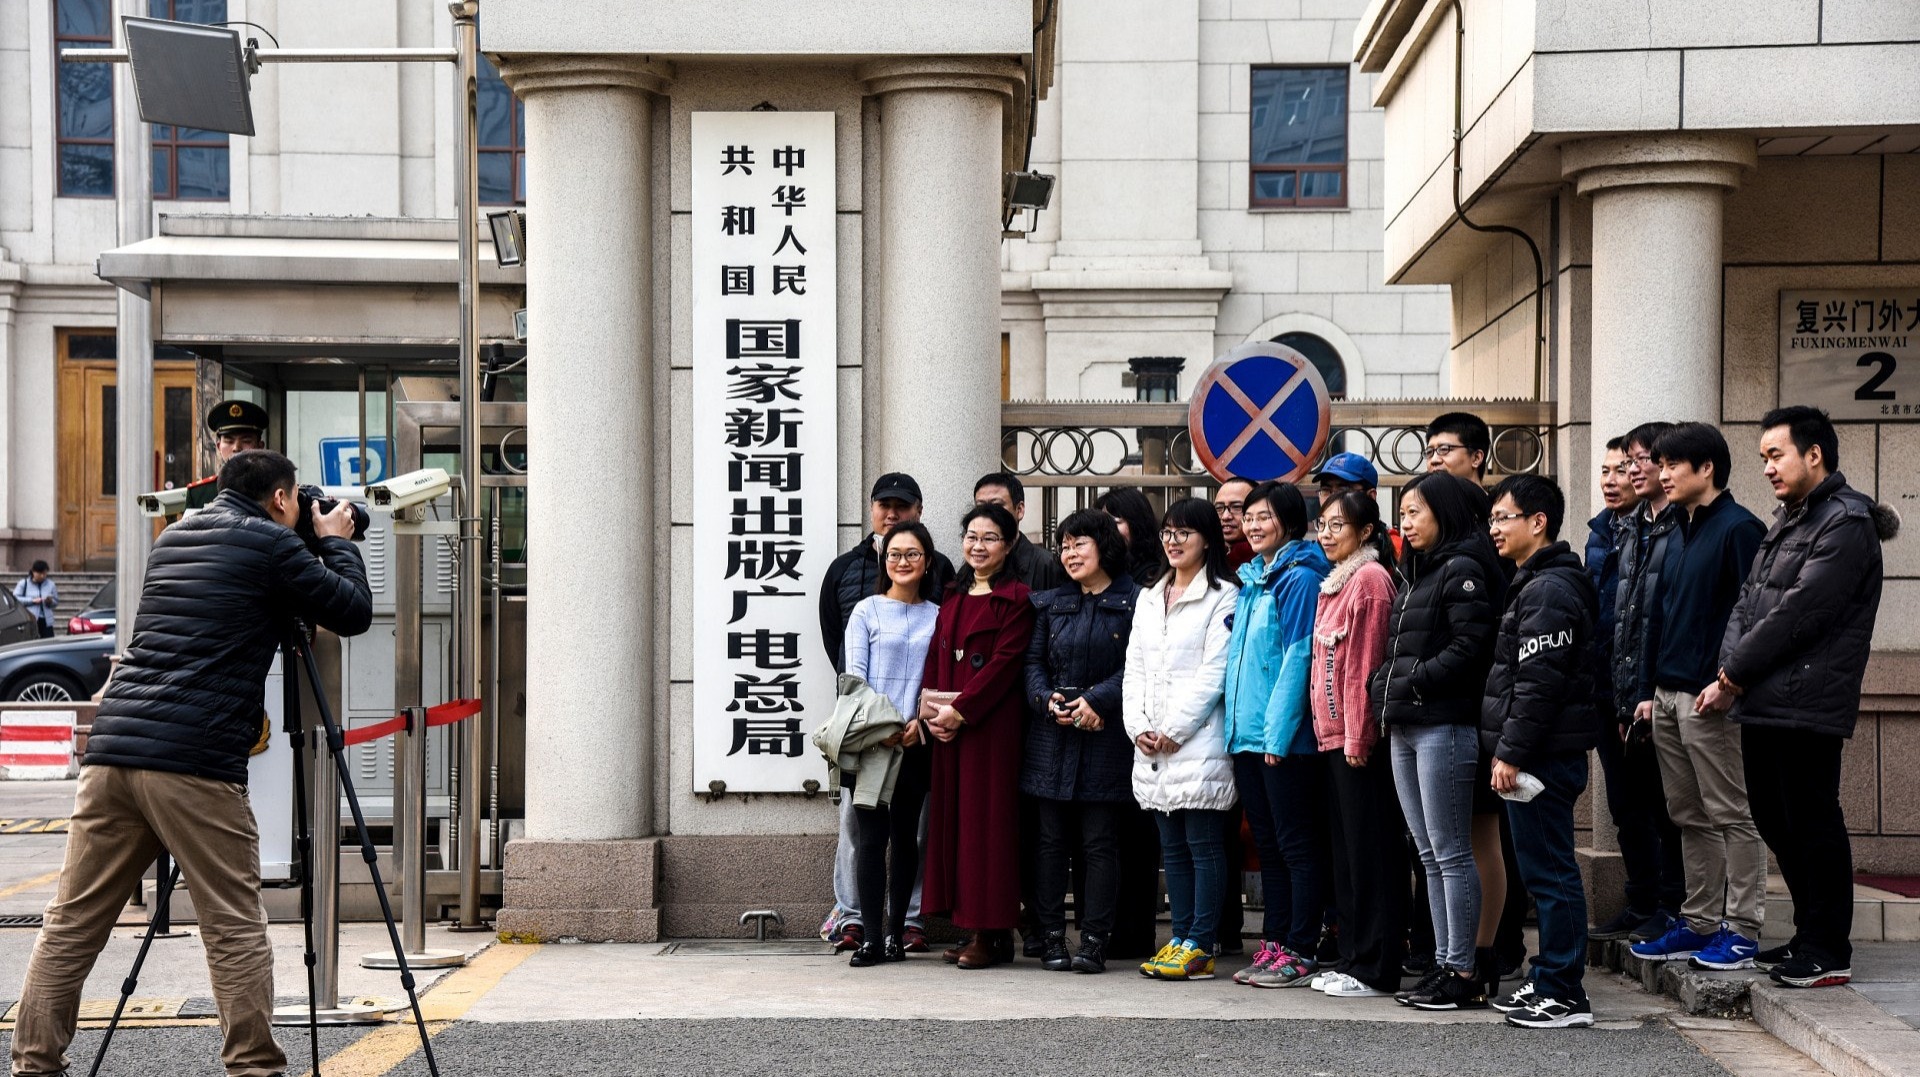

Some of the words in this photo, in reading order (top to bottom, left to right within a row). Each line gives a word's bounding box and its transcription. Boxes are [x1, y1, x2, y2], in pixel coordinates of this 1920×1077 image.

[720, 145, 755, 296] 共和国
[772, 145, 807, 296] 中华人民
[1791, 336, 1907, 349] FUXINGMENWAI
[1855, 352, 1896, 400] 2
[338, 447, 382, 487] P
[724, 318, 807, 757] 国家新闻出版广电总局
